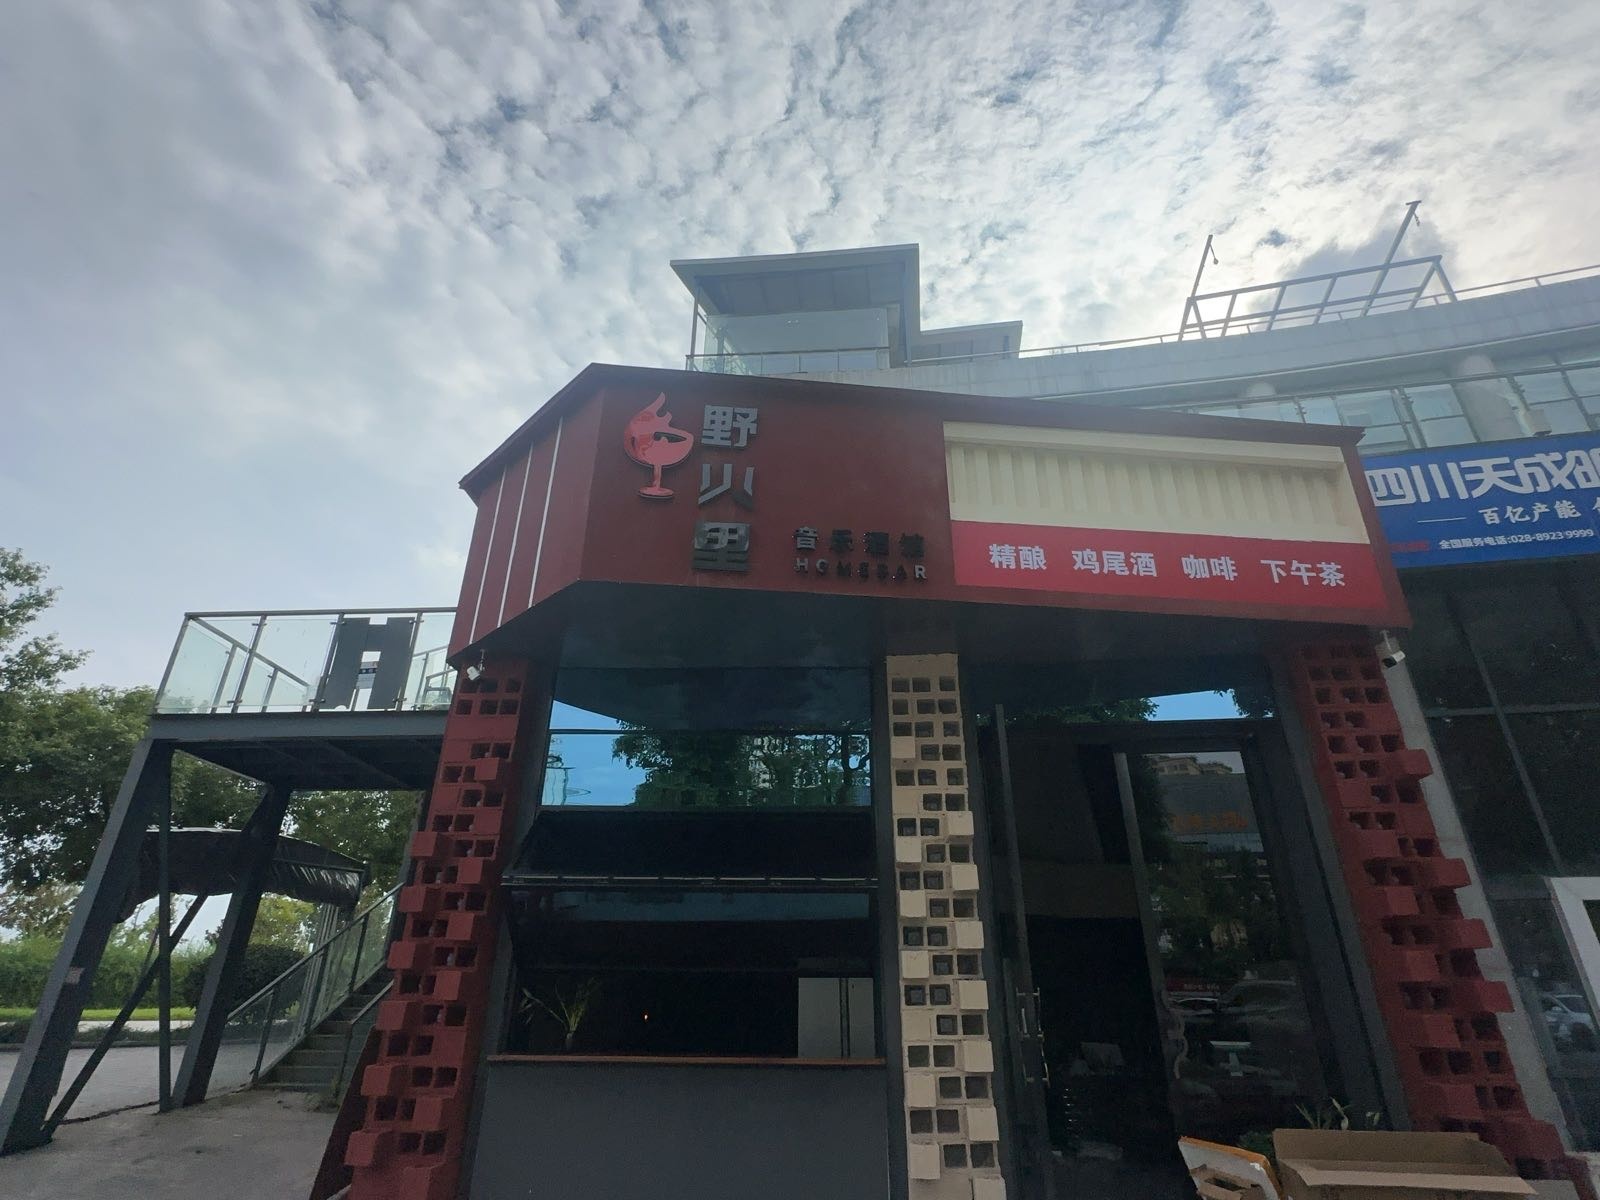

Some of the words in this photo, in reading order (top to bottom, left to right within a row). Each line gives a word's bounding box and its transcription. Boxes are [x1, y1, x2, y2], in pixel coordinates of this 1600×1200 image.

[1478, 499, 1582, 525] 百亿产能
[988, 543, 1048, 571] 精酿
[1071, 548, 1158, 578] 鸡尾酒
[1181, 553, 1238, 582] 咖啡
[1260, 558, 1346, 588] 下午茶
